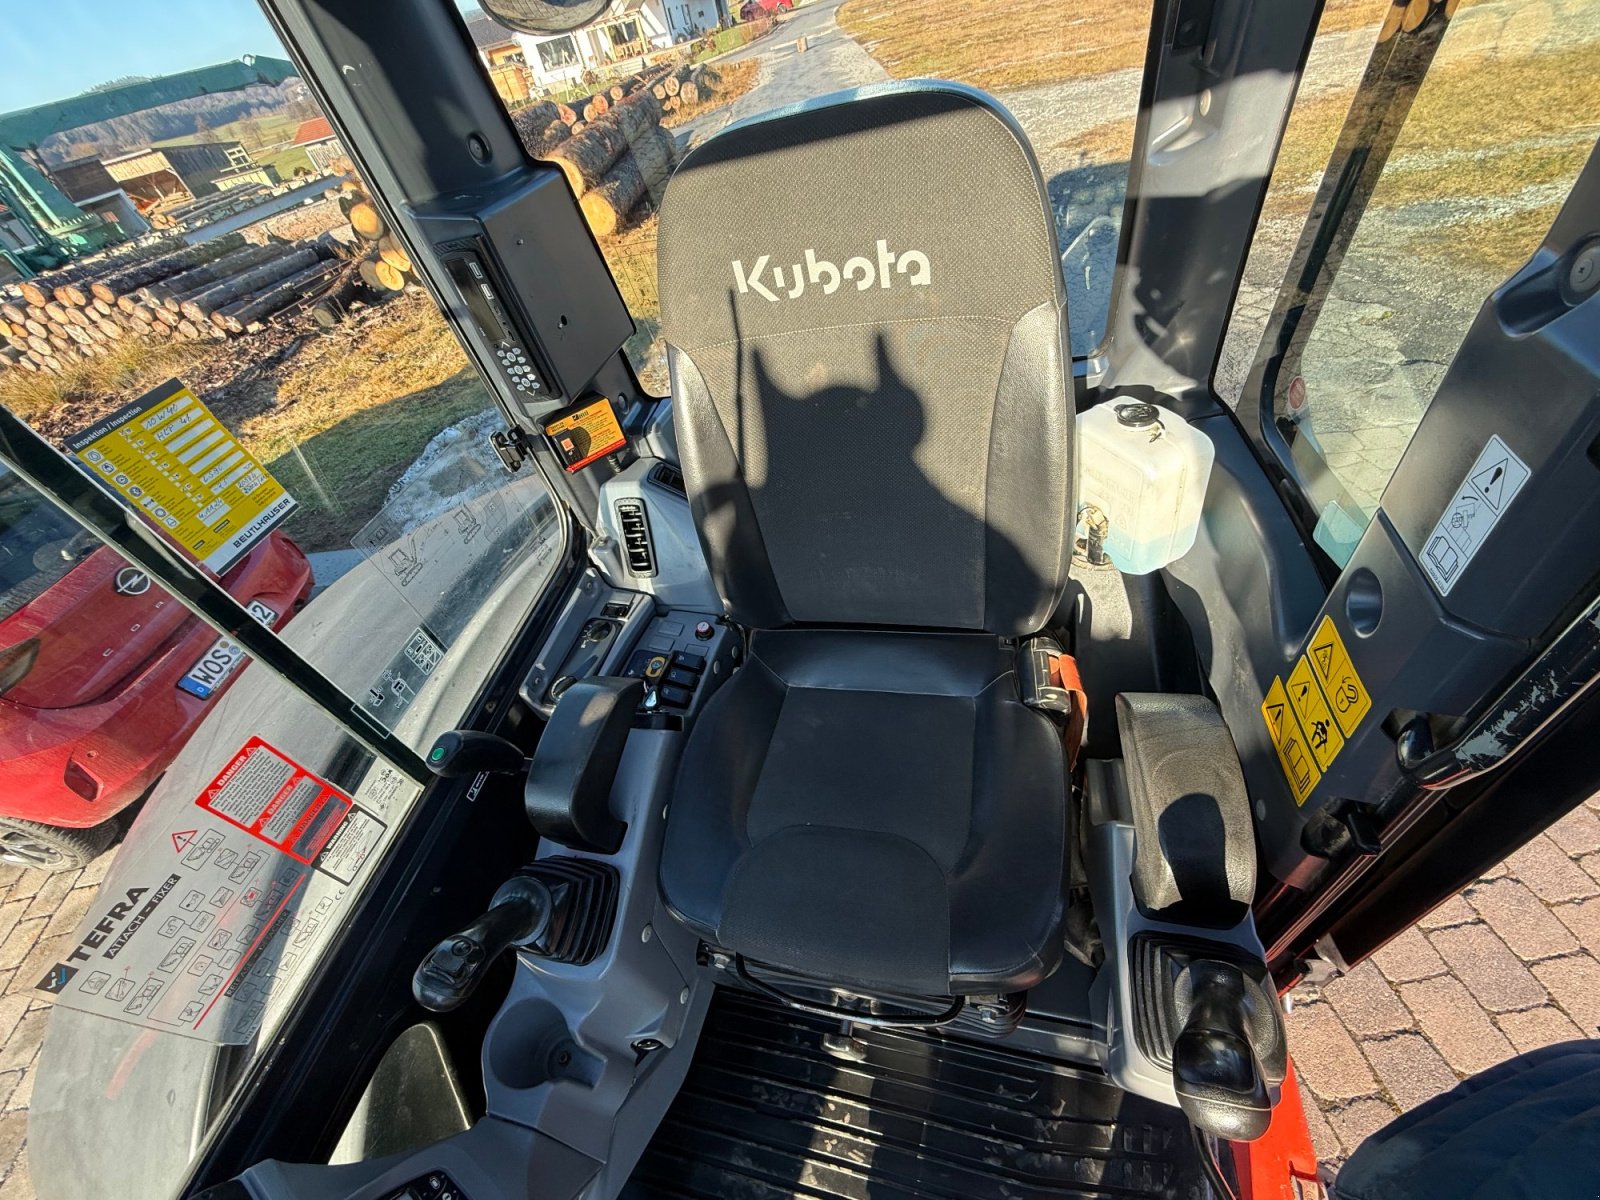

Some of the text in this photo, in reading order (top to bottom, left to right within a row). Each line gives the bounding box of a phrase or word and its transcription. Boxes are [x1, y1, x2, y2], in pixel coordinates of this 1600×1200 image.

[731, 239, 932, 302] Kubota
[72, 424, 108, 450] Inspektion
[109, 404, 142, 428] Inspection
[232, 497, 291, 548] BEUTLHAUSER
[192, 648, 232, 685] WOS
[217, 754, 247, 786] DANGER
[267, 784, 293, 814] DANGER
[296, 802, 321, 832] DANGER
[325, 820, 348, 849] WARNING
[66, 886, 150, 965] TEFRA
[107, 914, 145, 956] ATTACH
[152, 876, 177, 903] FIXER
